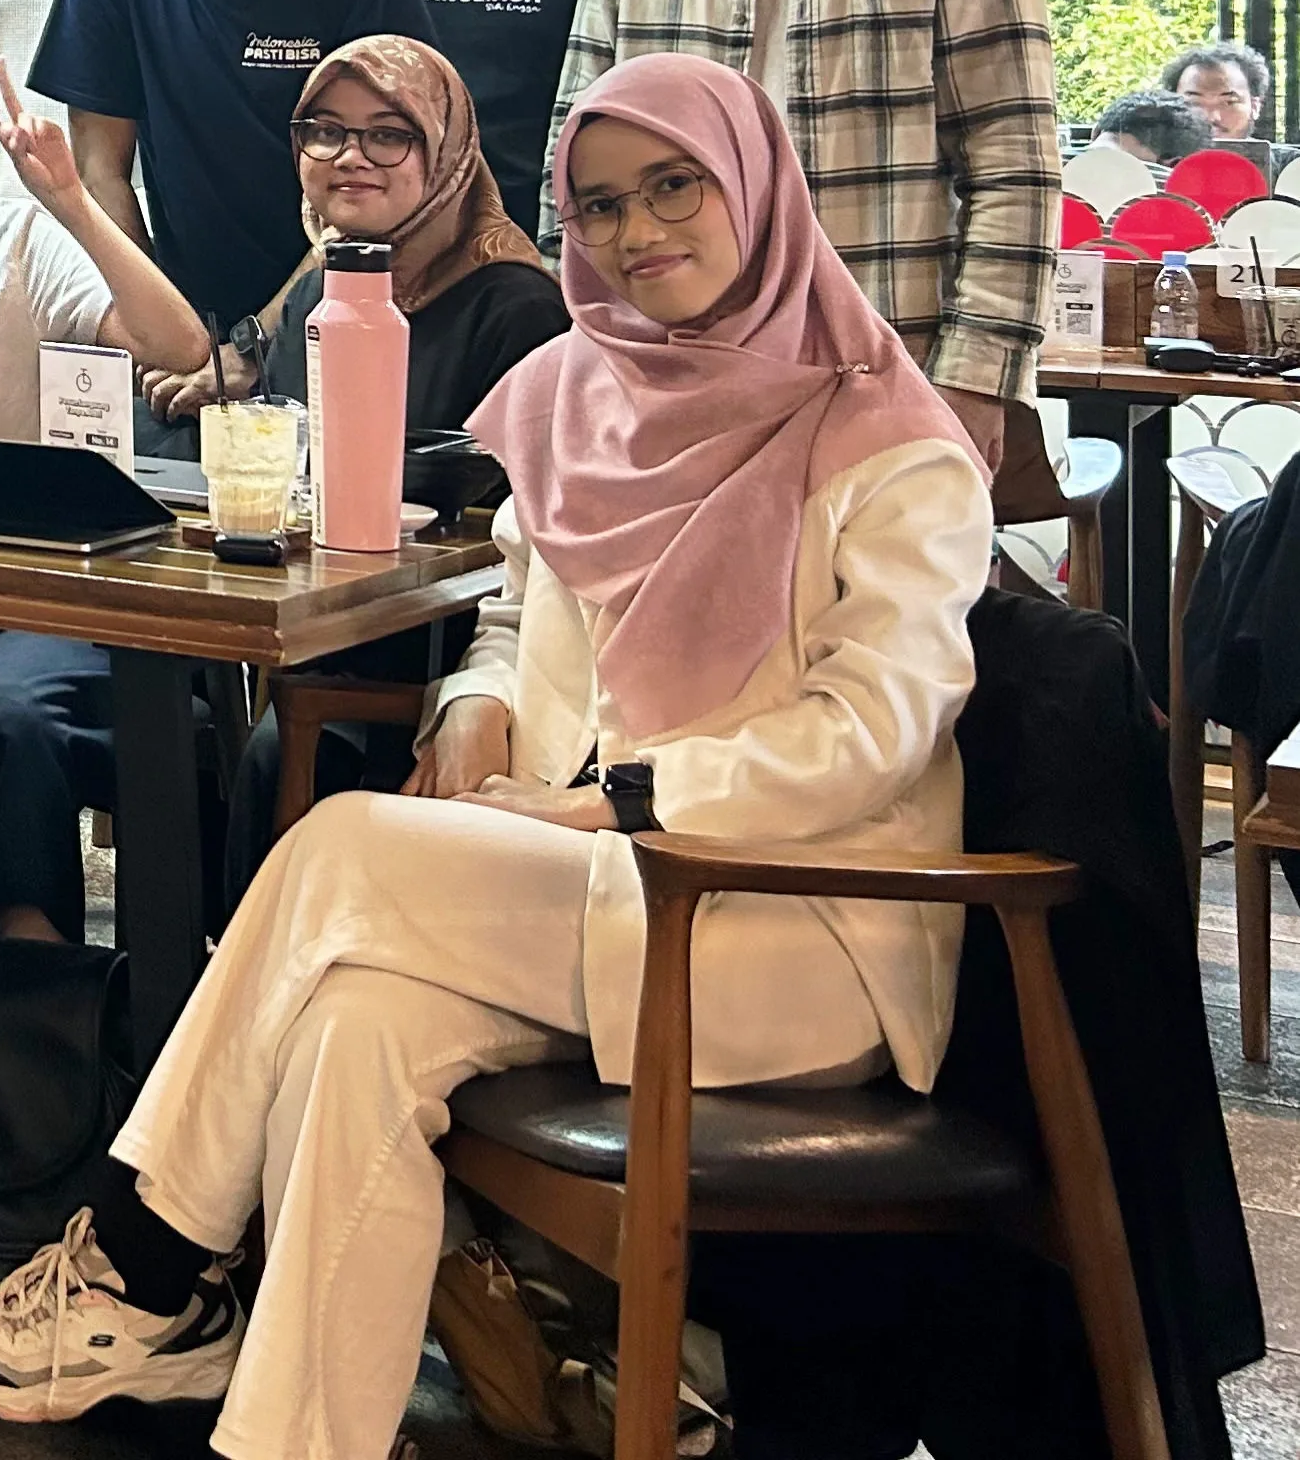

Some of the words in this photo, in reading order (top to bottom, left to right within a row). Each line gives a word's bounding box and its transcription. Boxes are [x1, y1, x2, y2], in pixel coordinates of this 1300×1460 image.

[246, 31, 321, 48] Indonesia
[243, 47, 283, 60] PASTI
[285, 48, 321, 61] BISA
[1230, 264, 1258, 284] 21
